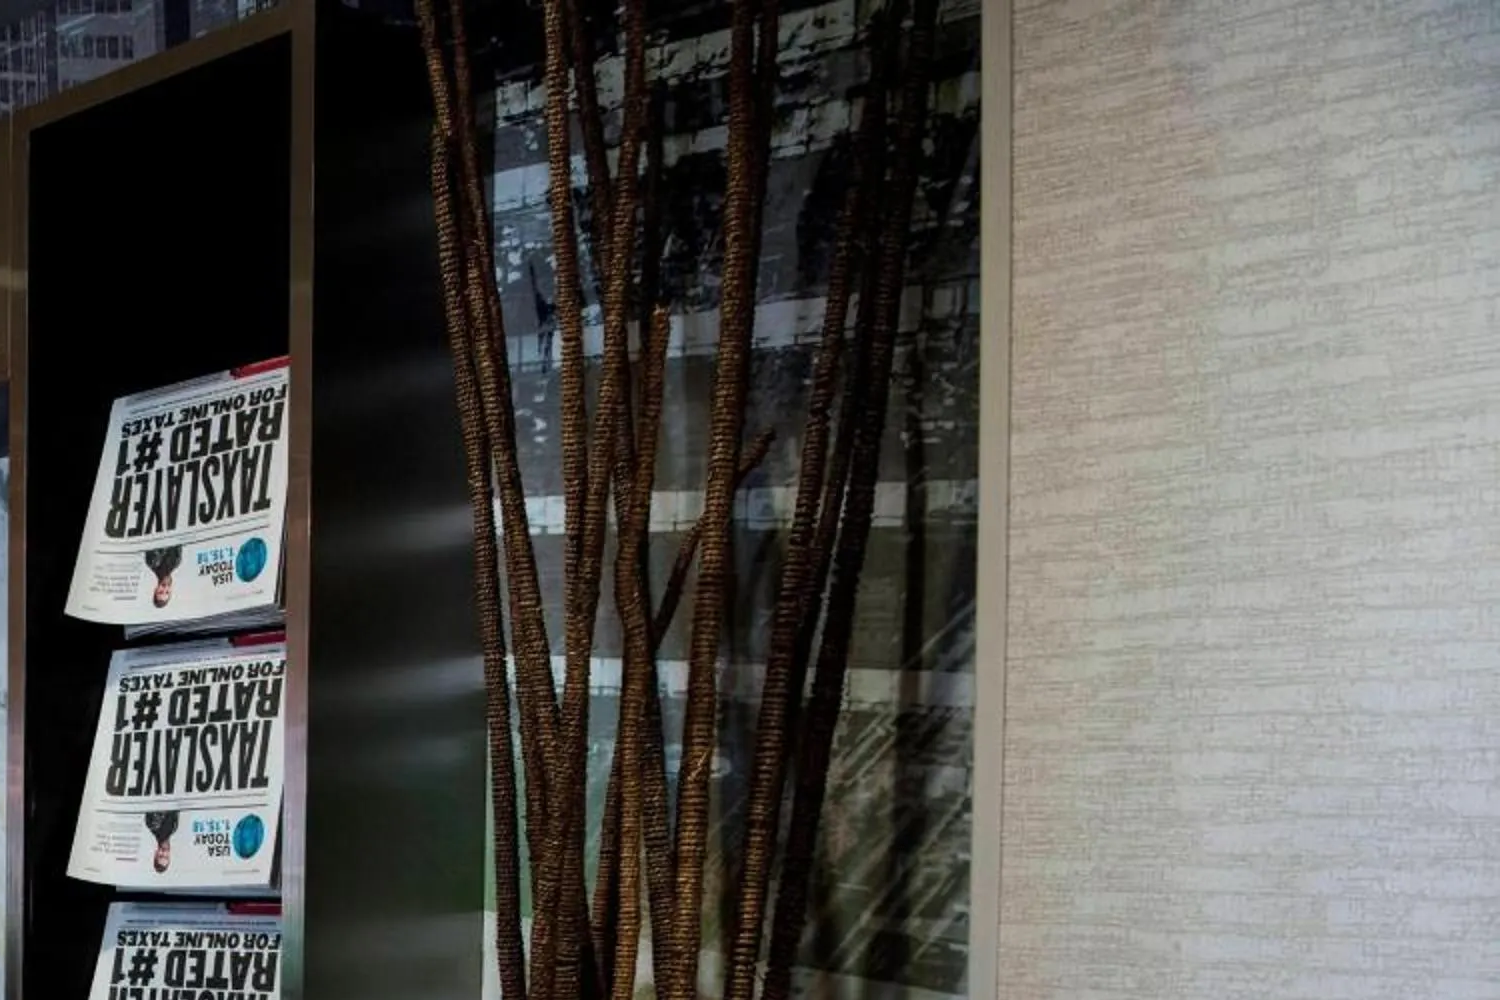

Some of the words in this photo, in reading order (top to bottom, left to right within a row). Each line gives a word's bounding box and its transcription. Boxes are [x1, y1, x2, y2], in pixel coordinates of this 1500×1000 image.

[249, 384, 287, 405] FOR
[178, 396, 244, 425] ONLINE
[121, 412, 176, 438] TAXES
[170, 402, 284, 462] RATED
[115, 431, 163, 475] #1
[105, 444, 273, 539] TAXSLAYER
[197, 547, 233, 562] 1.15.18
[199, 559, 233, 576] TODAY
[212, 574, 233, 587] USA
[178, 666, 245, 687] ONLINE
[248, 660, 285, 680] FOR
[120, 673, 174, 693] TAXES
[114, 692, 161, 732] #1
[169, 678, 282, 725] RATED
[106, 720, 272, 797] TAXSLAYER
[193, 820, 230, 832] 1.15.18
[193, 833, 230, 846] TODAY
[207, 845, 230, 857] USA
[118, 931, 172, 947] TAXES
[175, 931, 239, 948] ONLINE
[243, 933, 281, 950] FOR
[111, 948, 158, 986] #1
[164, 949, 277, 991] RATED
